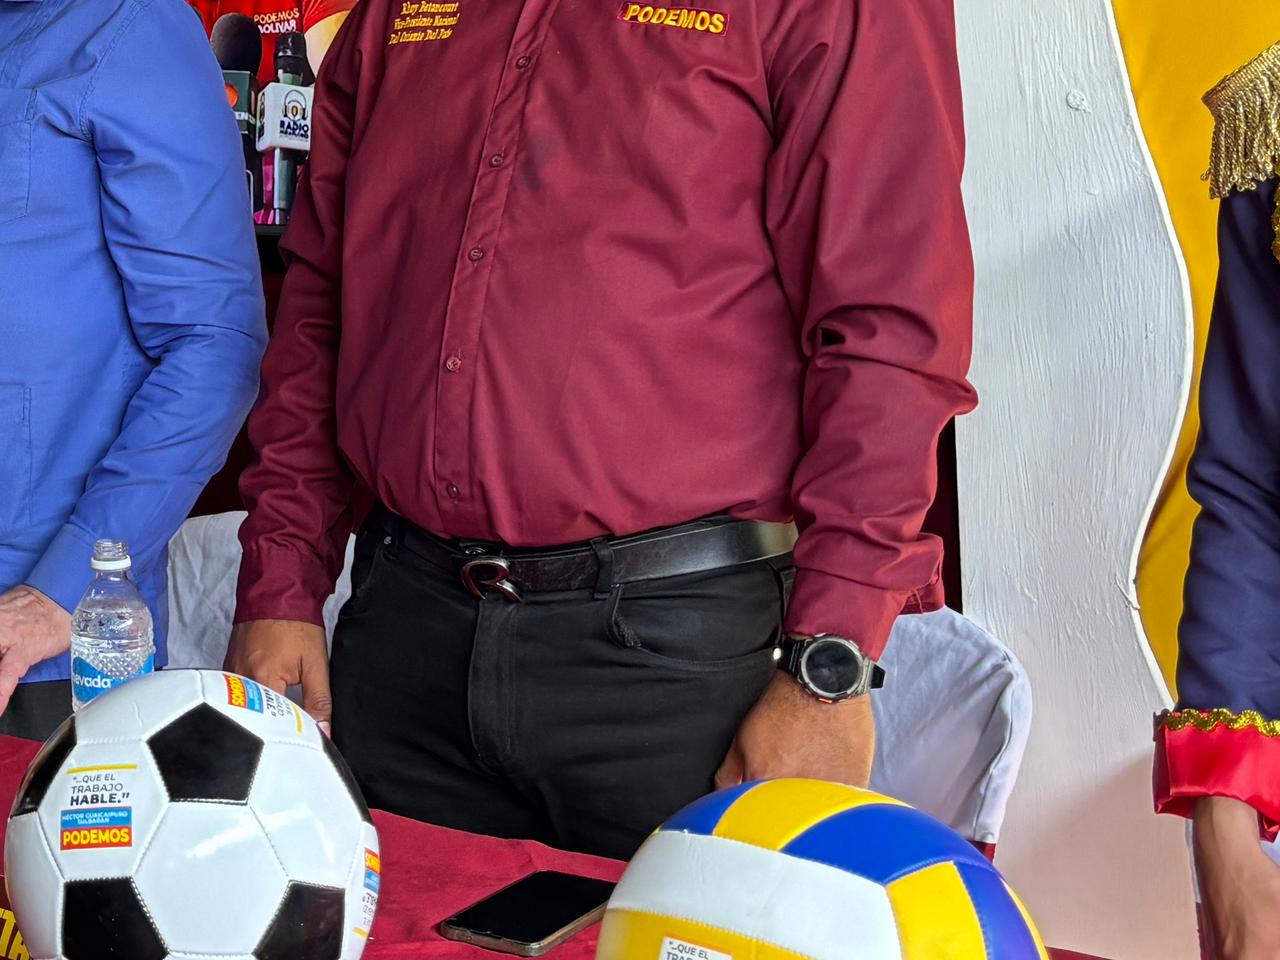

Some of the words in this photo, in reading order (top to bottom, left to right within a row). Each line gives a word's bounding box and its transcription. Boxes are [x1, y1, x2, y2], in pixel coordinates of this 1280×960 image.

[254, 8, 300, 24] PODEMOS
[623, 4, 725, 33] PODEMOS
[280, 120, 309, 133] RADIO
[104, 773, 117, 781] EL
[72, 783, 124, 794] TRABAJO
[63, 828, 130, 846] PODEMOS
